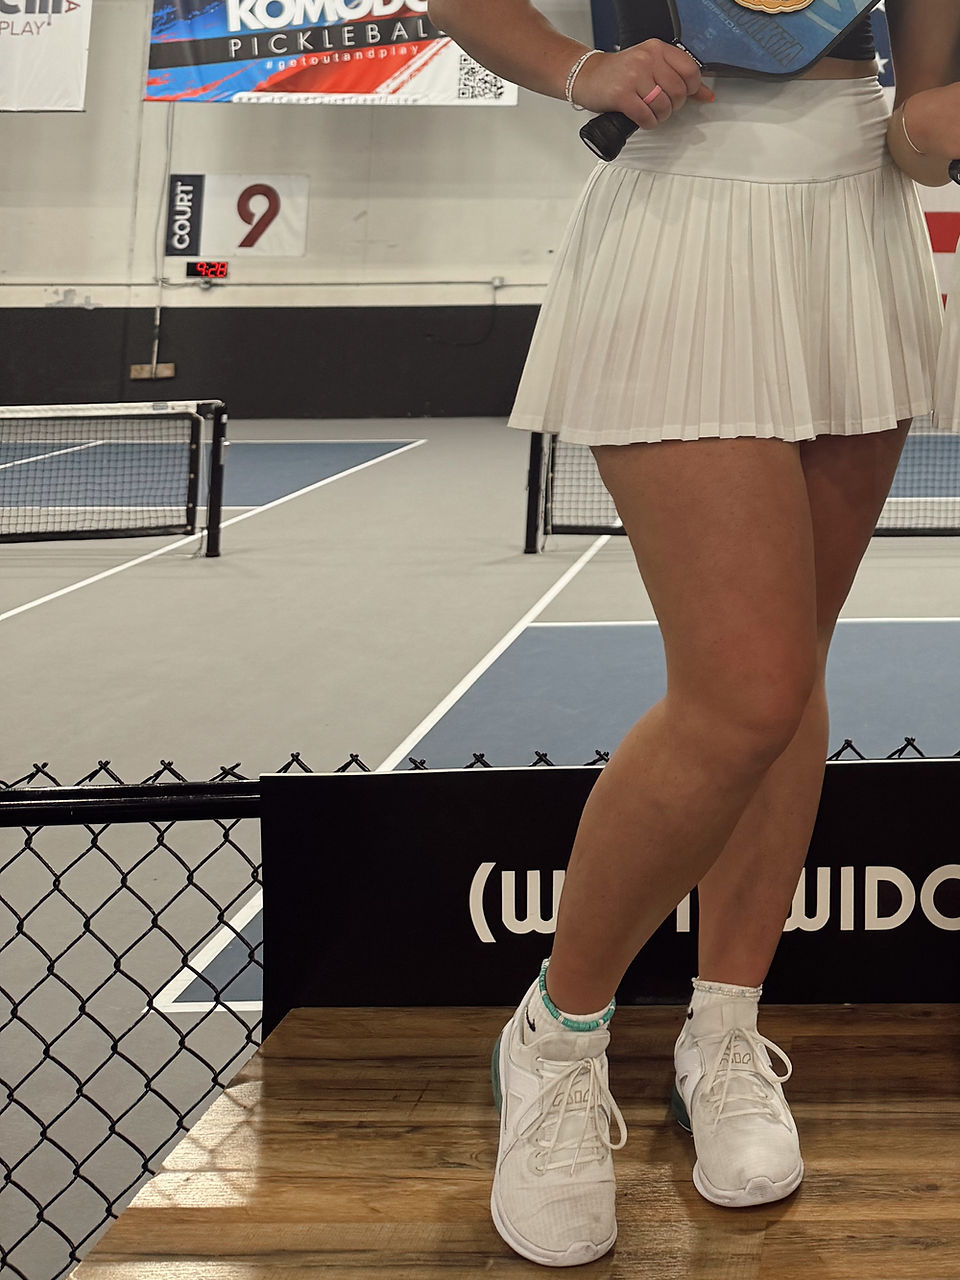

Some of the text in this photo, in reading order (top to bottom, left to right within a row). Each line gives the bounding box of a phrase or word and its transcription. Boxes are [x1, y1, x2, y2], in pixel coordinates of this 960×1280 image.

[229, 19, 447, 58] PICKLEBAL
[173, 181, 194, 250] COURT
[237, 183, 281, 248] 9
